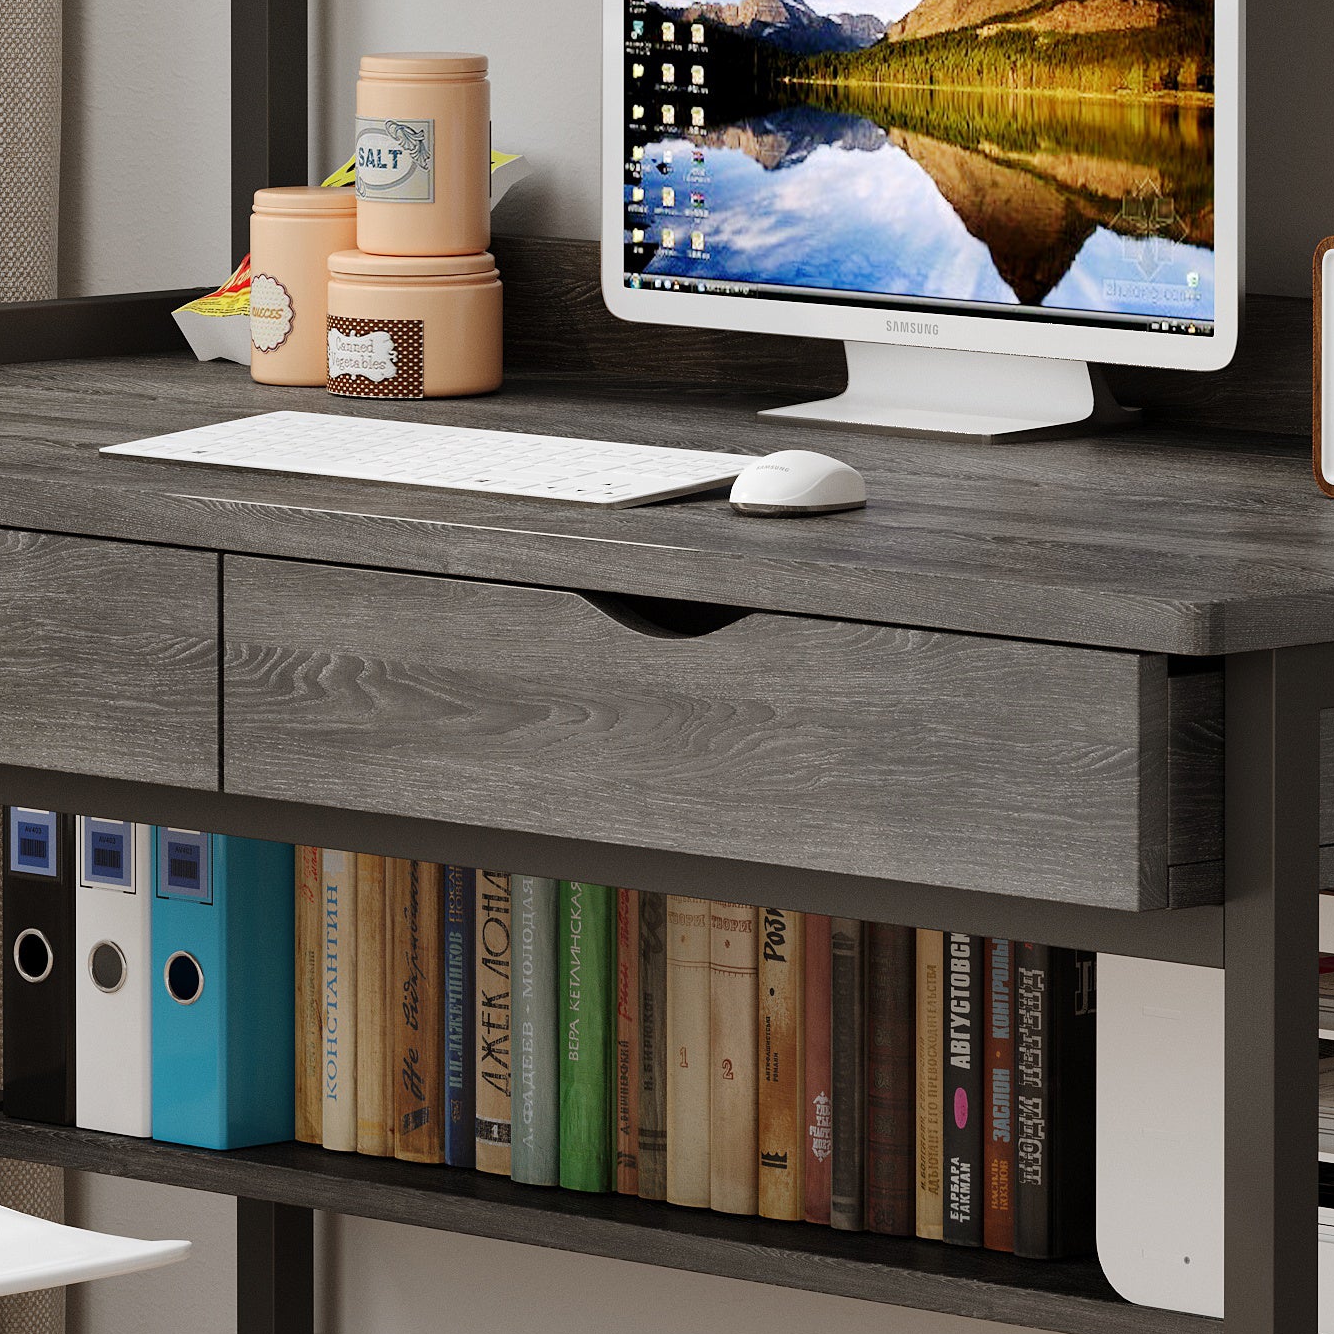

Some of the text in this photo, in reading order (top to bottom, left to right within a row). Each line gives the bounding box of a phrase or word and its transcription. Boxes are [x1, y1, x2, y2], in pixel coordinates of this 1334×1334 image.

[358, 148, 403, 170] SALT
[335, 336, 375, 354] Canned
[886, 320, 939, 336] SAMSUNG
[756, 464, 790, 473] SAMSUNG
[522, 878, 535, 999] МОЛОДАЯ
[326, 884, 338, 1101] КОНСТАНТИН
[568, 881, 582, 1061] ВЕРА КЕТЛИНСКАЯ
[481, 989, 511, 1097] ДЖЕК
[680, 1047, 688, 1068] 1
[722, 1058, 734, 1080] 2
[1018, 967, 1046, 1186] ЛЮДИ ЛЕГЕНД
[927, 1102, 938, 1125] ЕГО
[992, 1068, 1011, 1143] ЗАСЛОН
[489, 1124, 499, 1139] 1
[950, 1156, 960, 1221] БАРБАРА
[960, 1162, 971, 1223] ТАКМАН
[999, 1160, 1009, 1211] КОЗЛОВ
